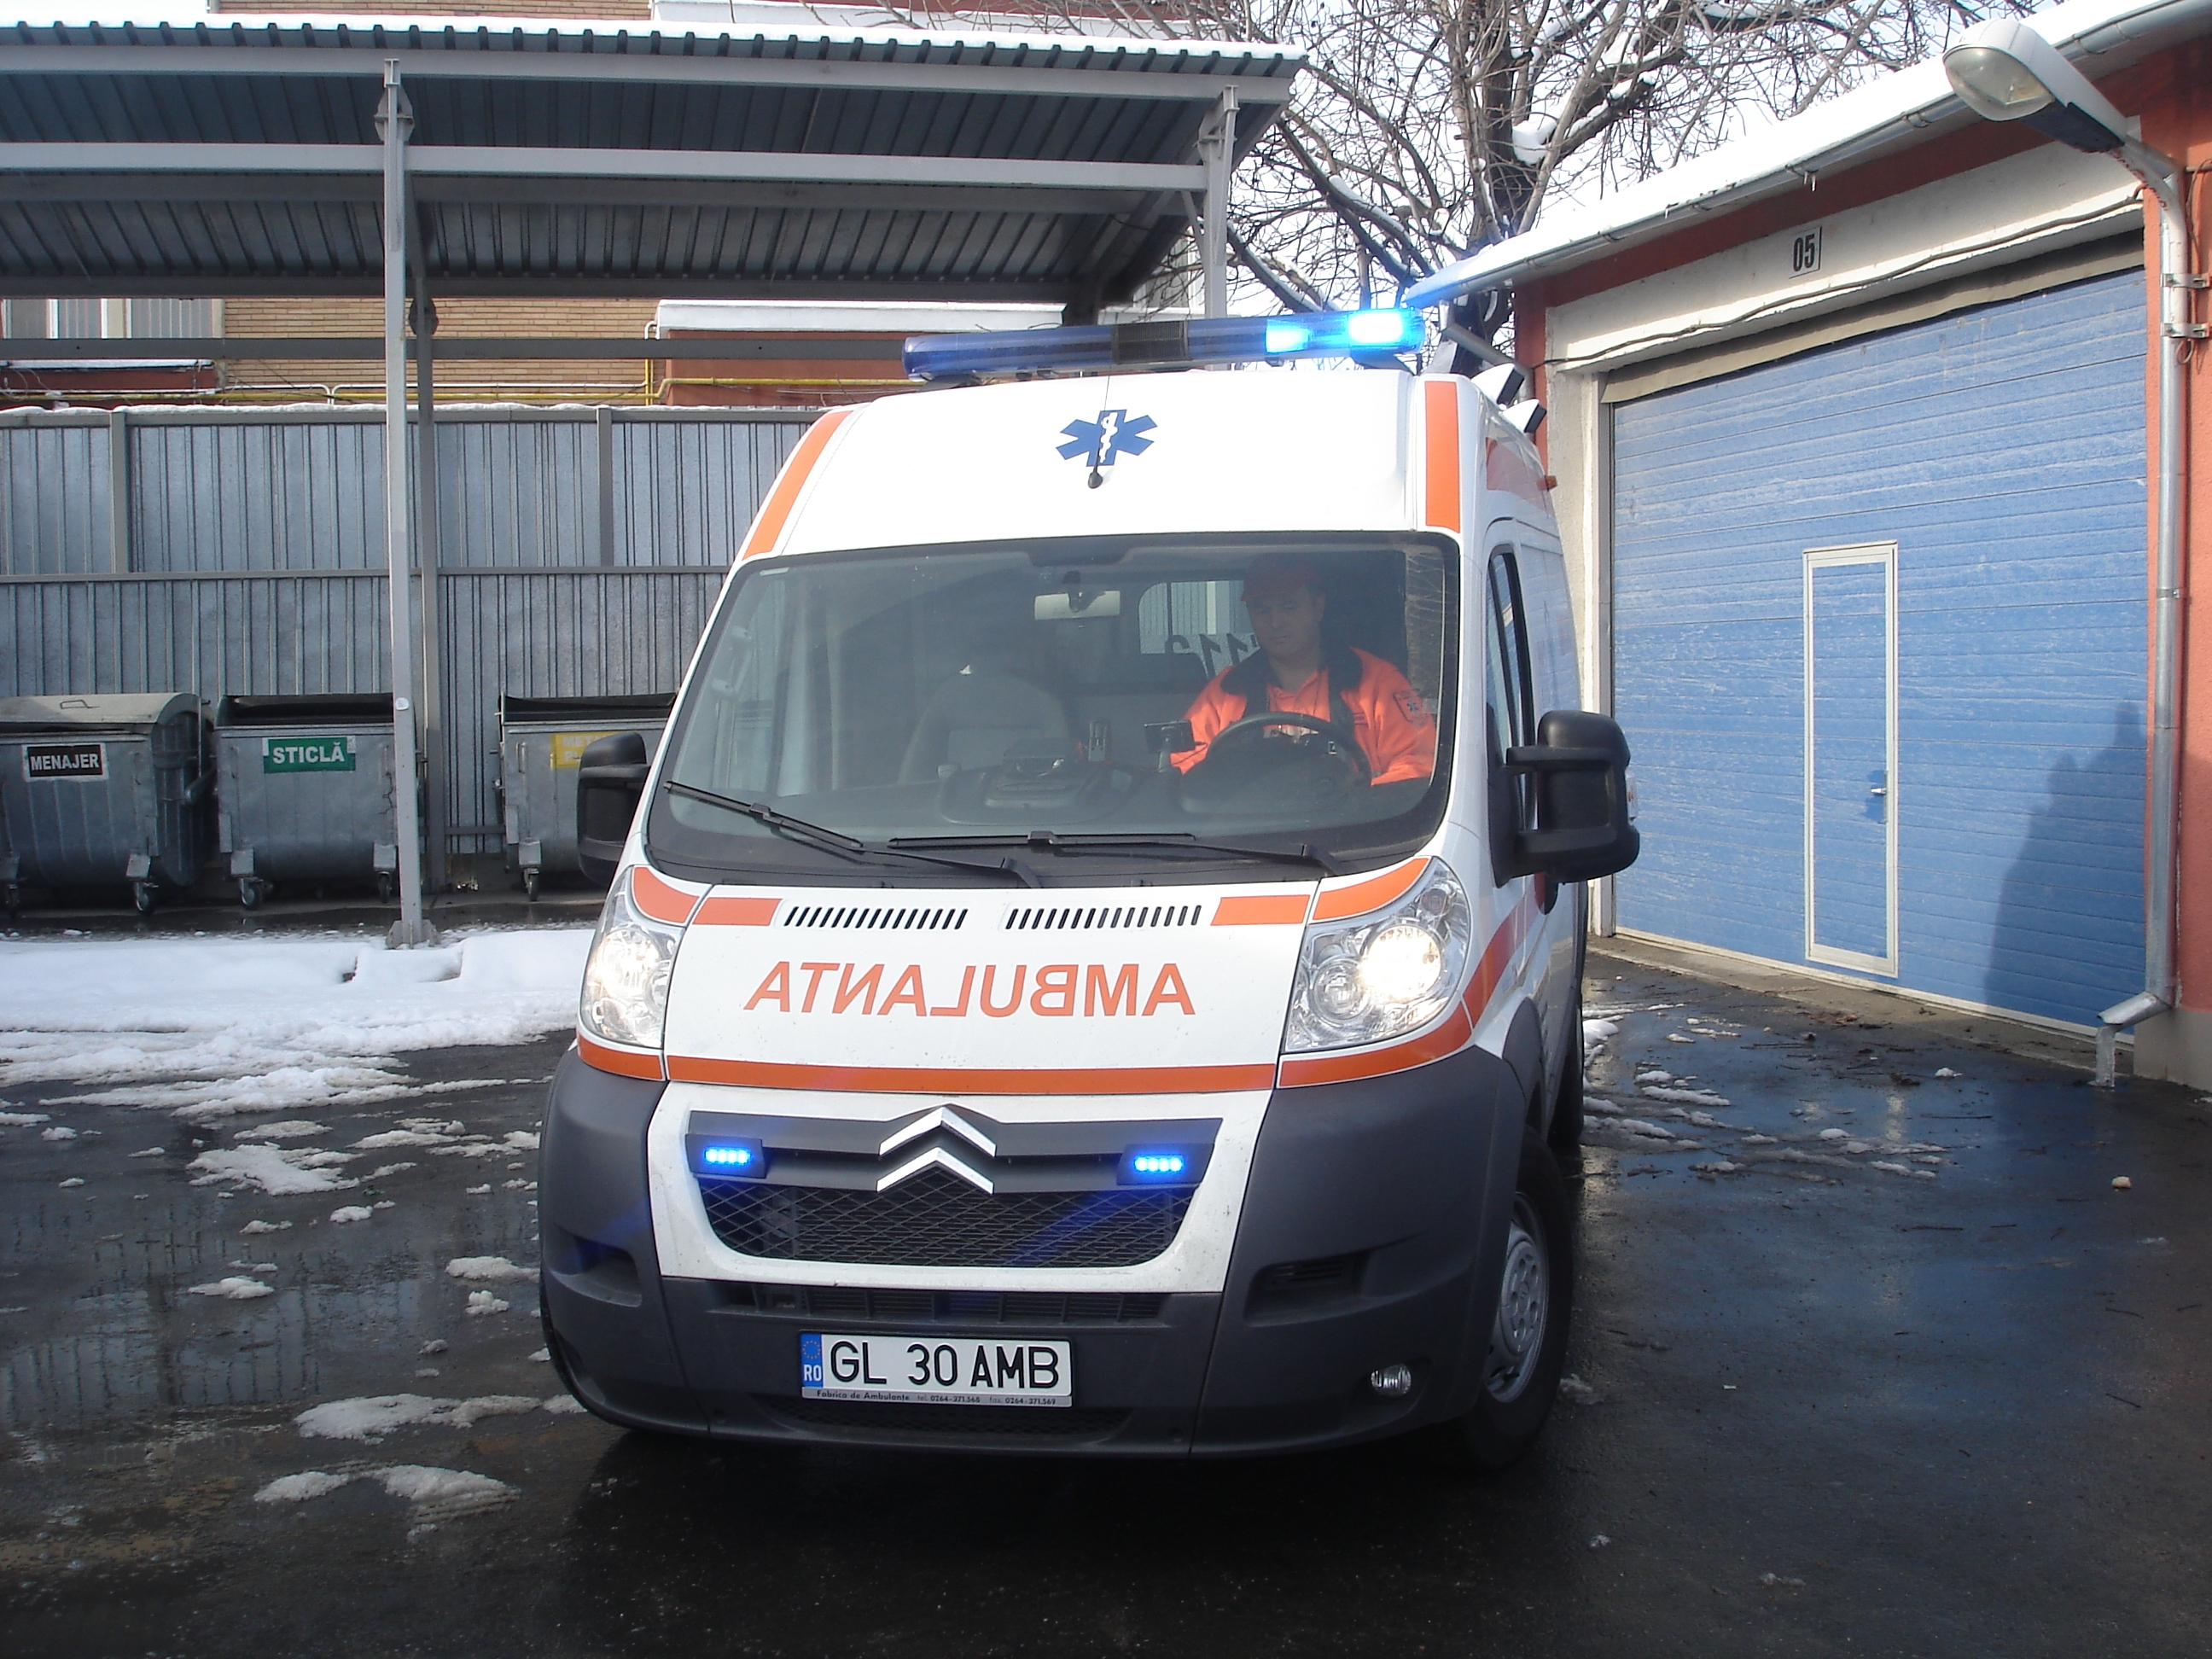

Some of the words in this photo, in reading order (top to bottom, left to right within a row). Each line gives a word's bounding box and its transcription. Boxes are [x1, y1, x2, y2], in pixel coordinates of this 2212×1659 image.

[1793, 233, 1815, 272] 05
[30, 753, 100, 771] MENAJER
[272, 741, 345, 765] STICLĂ
[802, 1364, 823, 1382] RO
[830, 1340, 888, 1385] GL
[906, 1343, 958, 1387] 30
[969, 1344, 1060, 1389] AMB
[817, 1389, 848, 1400] Fabrica
[850, 1391, 861, 1400] de
